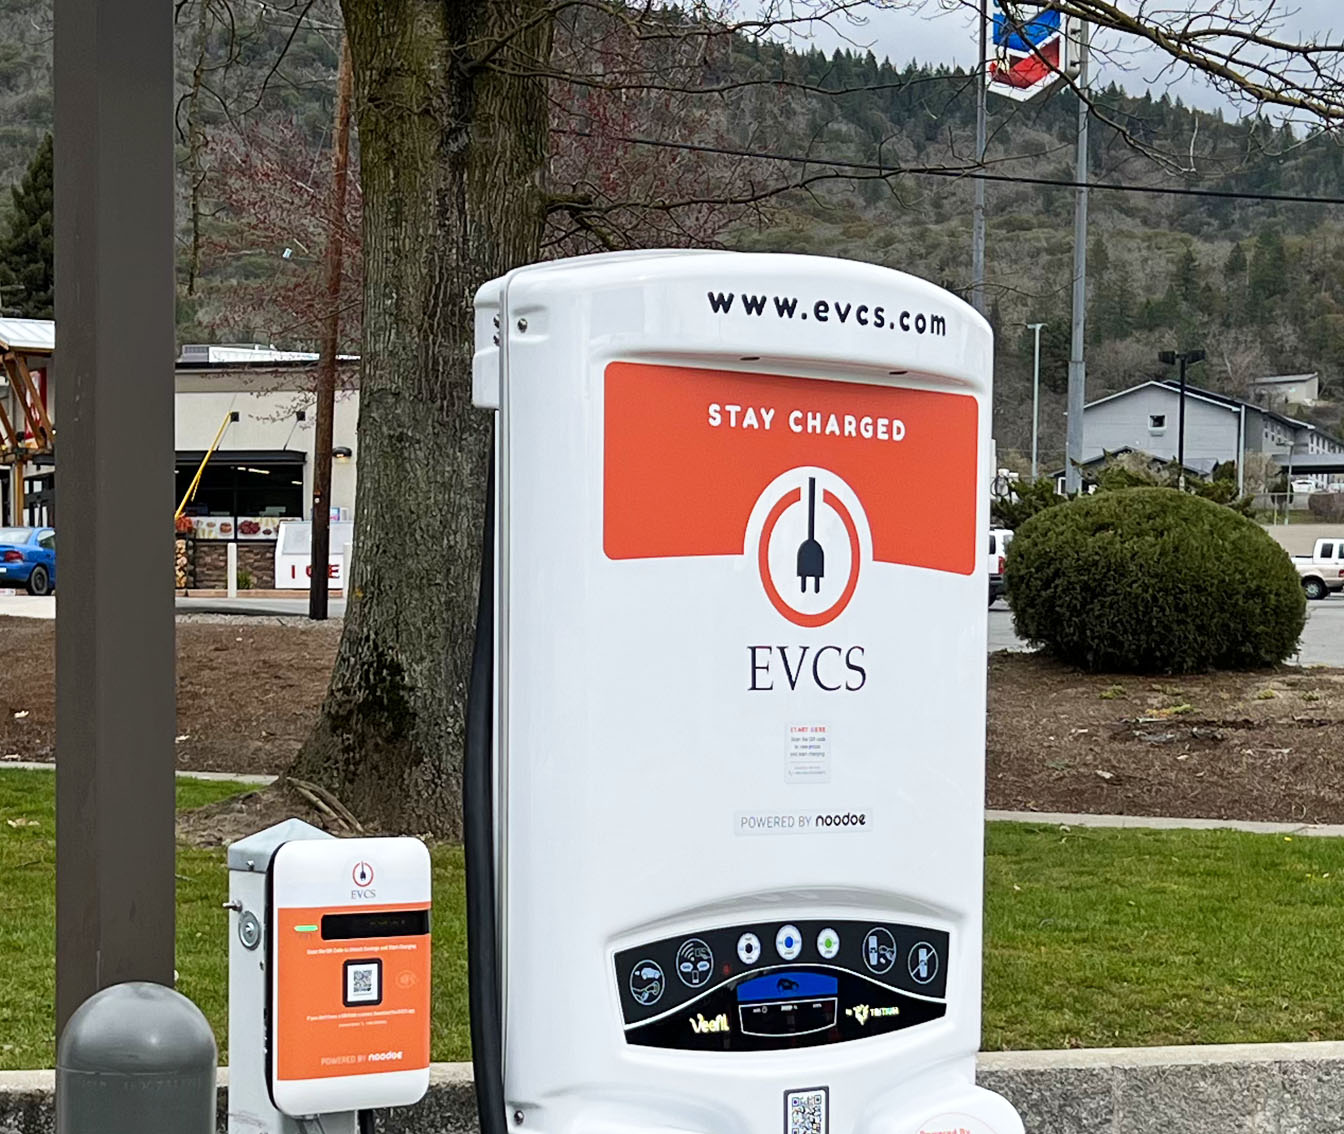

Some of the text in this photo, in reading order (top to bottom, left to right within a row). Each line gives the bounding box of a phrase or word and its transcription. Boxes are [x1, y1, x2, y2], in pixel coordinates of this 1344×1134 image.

[707, 291, 946, 336] www.evcs.com
[708, 403, 906, 441] STAY CHARGED
[746, 645, 867, 692] EVCS
[741, 812, 866, 828] POWERED BY noodoe
[351, 889, 376, 899] EVCS
[368, 1051, 403, 1062] noodoe
